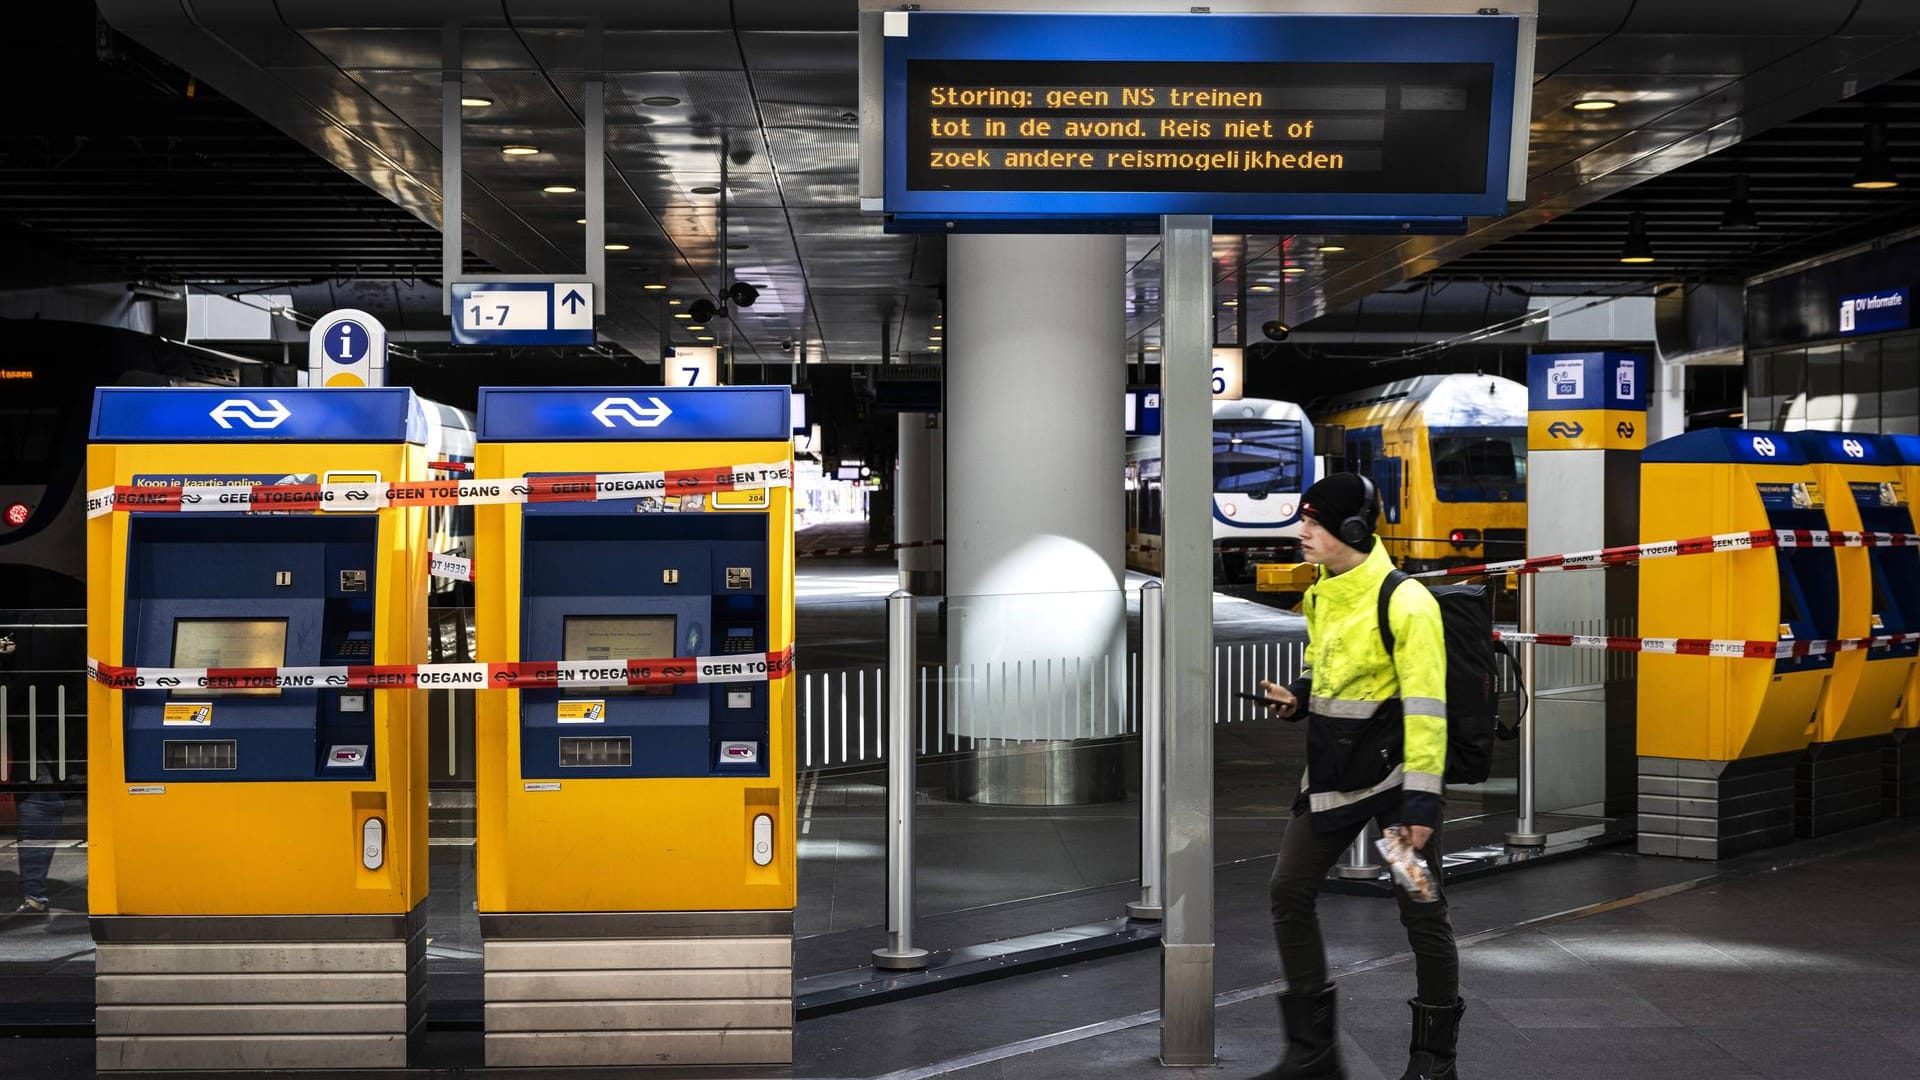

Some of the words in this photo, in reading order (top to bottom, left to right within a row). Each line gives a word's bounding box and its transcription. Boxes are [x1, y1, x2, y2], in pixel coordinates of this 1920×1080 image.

[930, 87, 1032, 108] Storing:
[1046, 90, 1108, 108] geen
[1122, 88, 1155, 106] NS
[1169, 88, 1263, 106] treinen
[931, 118, 972, 137] tot
[985, 118, 1006, 137] in
[1019, 118, 1051, 137] de
[1064, 118, 1146, 137] avond.
[1160, 119, 1211, 137] Reis
[1225, 120, 1273, 137] niet
[1287, 120, 1314, 138] of
[930, 150, 991, 168] zoek
[1004, 150, 1094, 168] andere
[1107, 150, 1344, 171] reismogelijkheden
[1867, 292, 1903, 310] Informatie
[470, 305, 510, 326] 1-7
[682, 367, 700, 387] 7
[1212, 367, 1226, 394] 6
[136, 478, 168, 488] Koop
[184, 478, 225, 488] kaartje
[716, 472, 756, 485] GEEN
[385, 488, 424, 500] GEEN
[429, 486, 500, 499] TOEGANG
[552, 484, 590, 494] GEEN
[596, 480, 665, 493] TOEGANG
[104, 492, 168, 506] TOEGANG
[219, 493, 258, 504] GEEN
[263, 491, 335, 503] TOEGANG
[535, 670, 575, 681] GEEN
[579, 668, 651, 680] TOEGANG
[703, 664, 742, 676] GEEN
[198, 676, 237, 687] GEEN
[242, 676, 314, 687] TOEGANG
[367, 674, 406, 685] GEEN
[413, 672, 483, 684] TOEGANG
